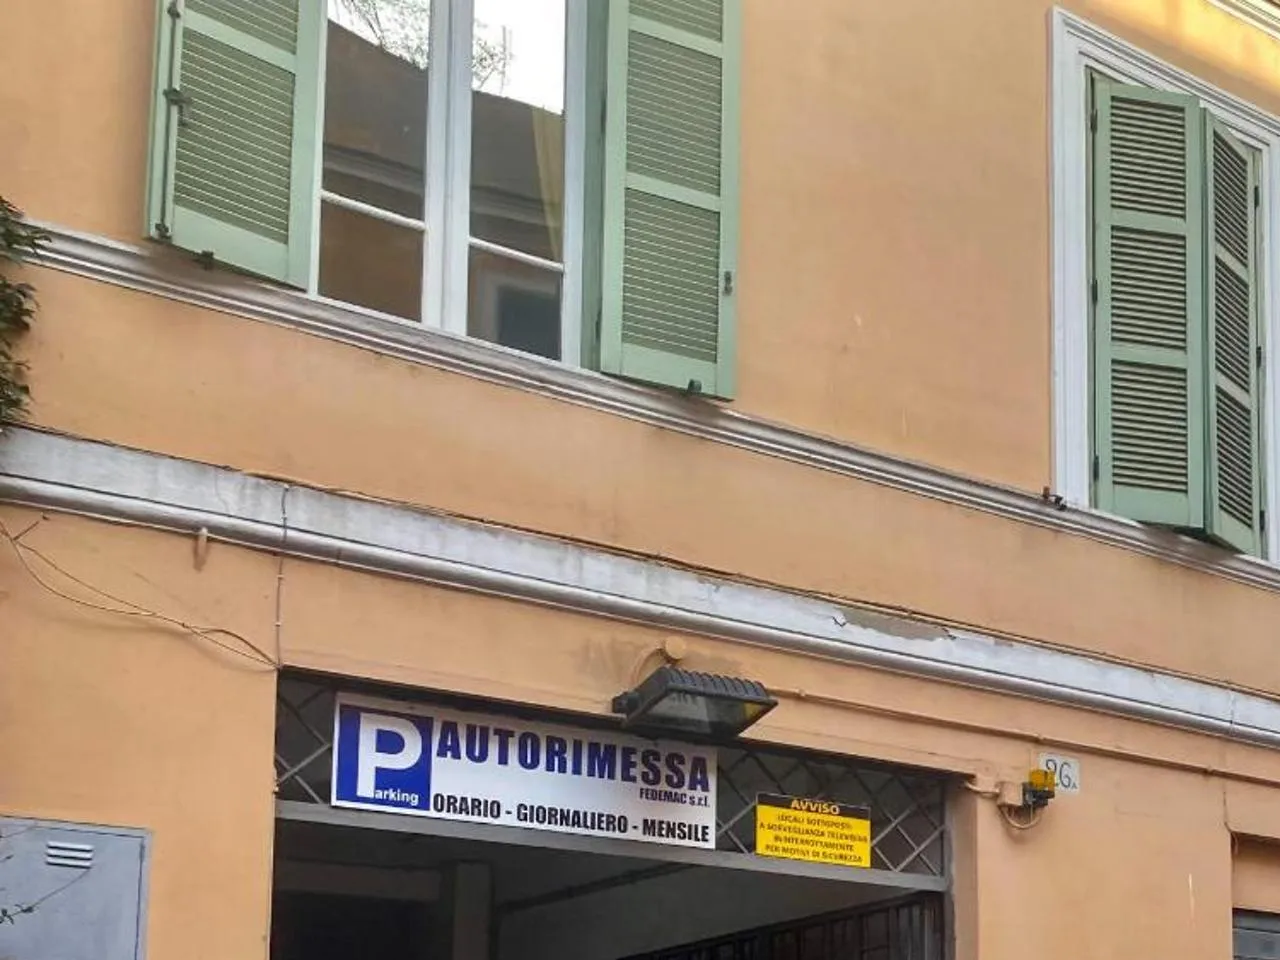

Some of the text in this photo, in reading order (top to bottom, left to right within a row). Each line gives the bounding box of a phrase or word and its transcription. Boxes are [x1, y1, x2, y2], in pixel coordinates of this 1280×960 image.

[436, 720, 711, 792] AUTORIMESSA
[640, 787, 687, 805] FEDEMAC
[791, 799, 841, 815] AVVISO
[433, 793, 501, 819] ORARIO
[516, 803, 628, 834] GIORNALIERO
[642, 818, 710, 842] MENSILE
